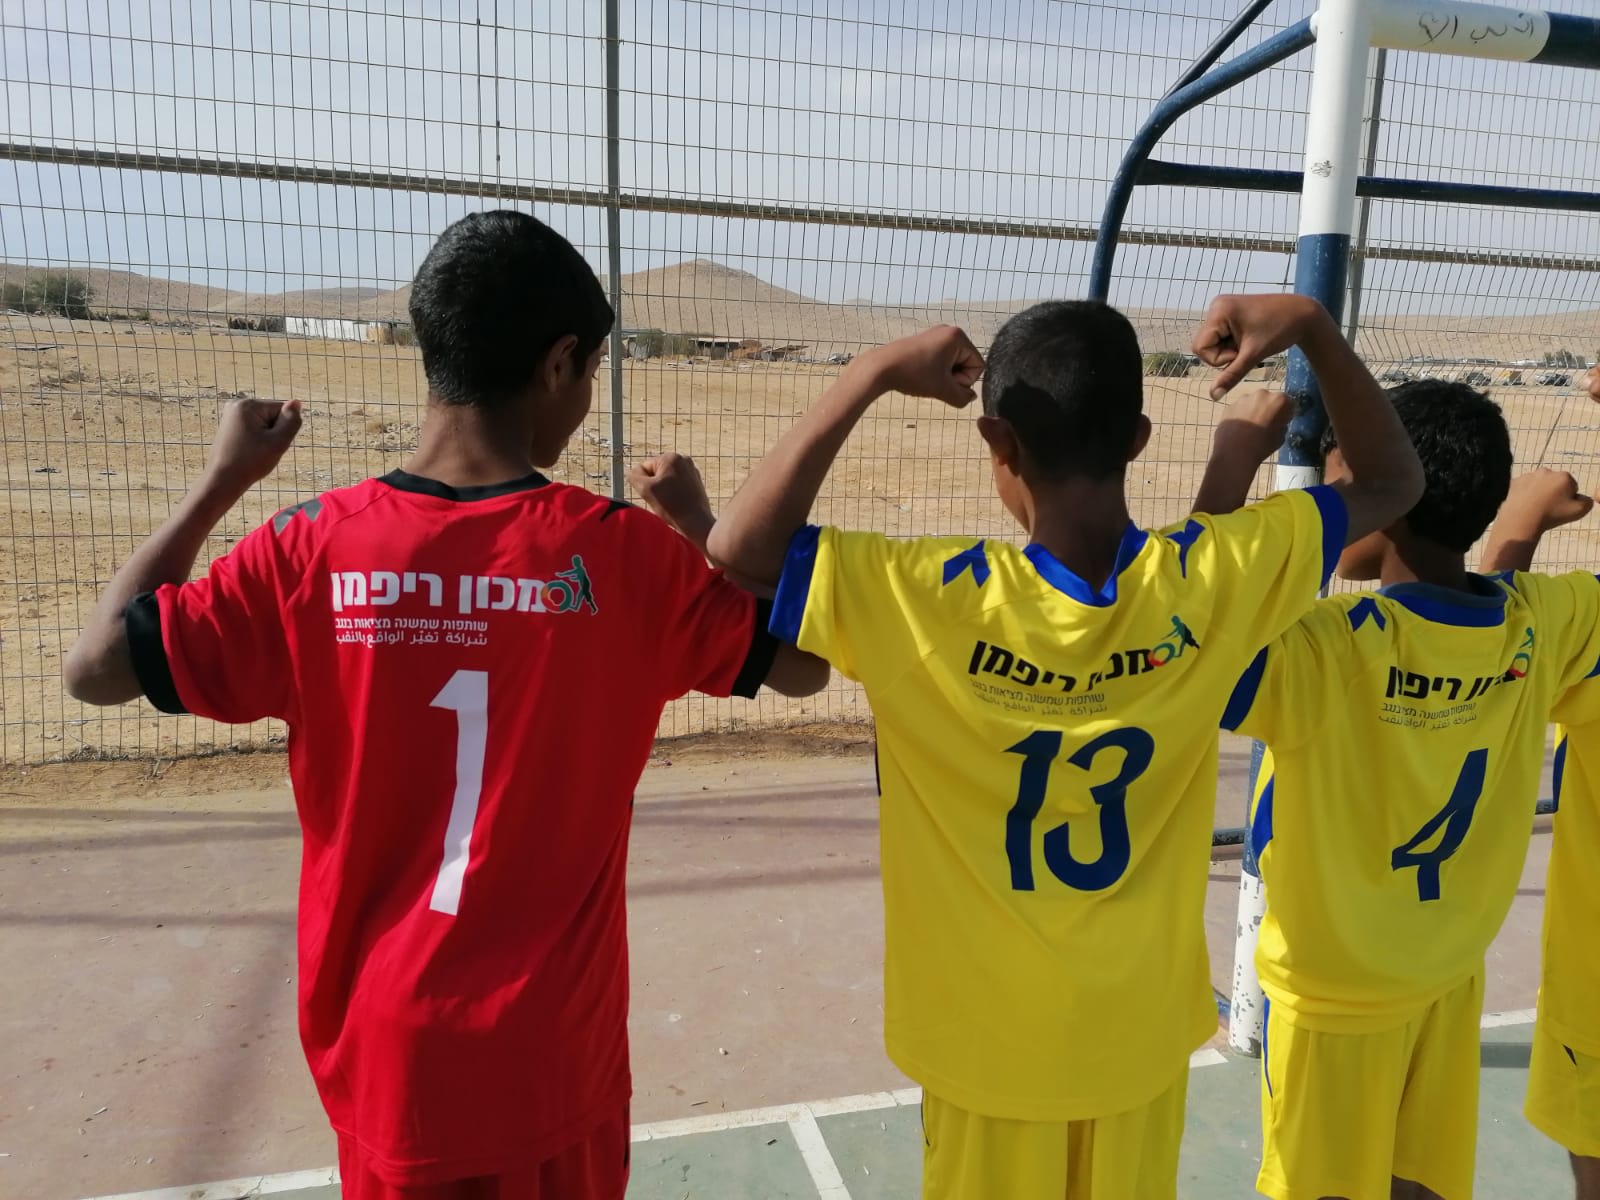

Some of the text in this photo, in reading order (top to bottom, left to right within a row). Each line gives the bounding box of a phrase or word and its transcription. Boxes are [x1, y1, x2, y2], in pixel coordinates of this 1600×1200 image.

[331, 571, 546, 614] מכון ריפמן
[354, 617, 391, 629] מציאות
[394, 617, 439, 630] שמשנה
[443, 620, 488, 631] שותפות
[336, 631, 366, 645] بالنقب
[366, 630, 404, 649] الواقع
[446, 631, 488, 647] شراكة
[968, 639, 1077, 692] ריפמן
[430, 670, 490, 916] 1
[1005, 727, 1155, 891] 13
[1392, 750, 1487, 902] 4
